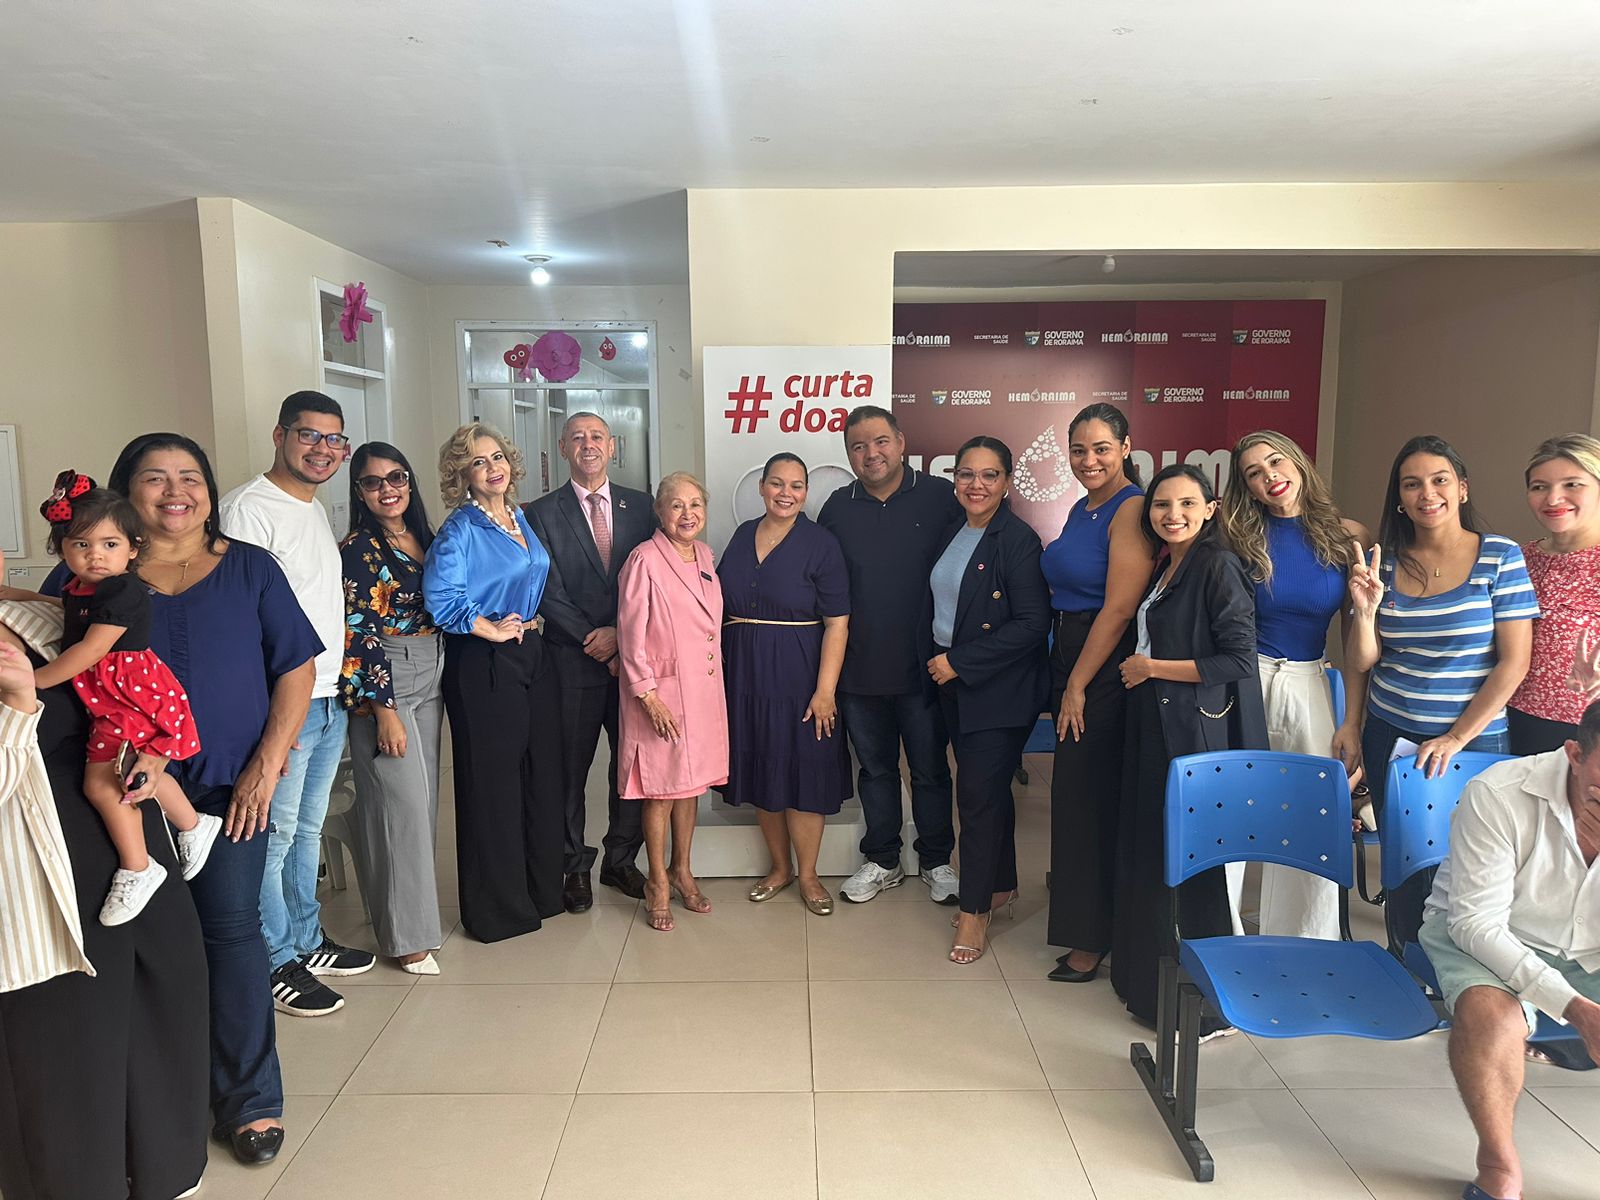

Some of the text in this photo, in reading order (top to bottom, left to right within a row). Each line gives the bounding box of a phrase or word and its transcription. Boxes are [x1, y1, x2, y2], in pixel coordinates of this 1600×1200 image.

[892, 331, 950, 345] EMORAIMA
[1044, 331, 1084, 339] GOVERNO
[1101, 329, 1168, 343] HEMORAIMA
[1252, 330, 1292, 338] GOVERNO
[784, 371, 873, 398] curta
[951, 390, 991, 398] GOVERNO
[1008, 388, 1076, 402] HEMORAIMA
[1163, 388, 1203, 396] GOVERNO
[1223, 386, 1290, 400] HEMORAIMA
[779, 400, 848, 433] doa
